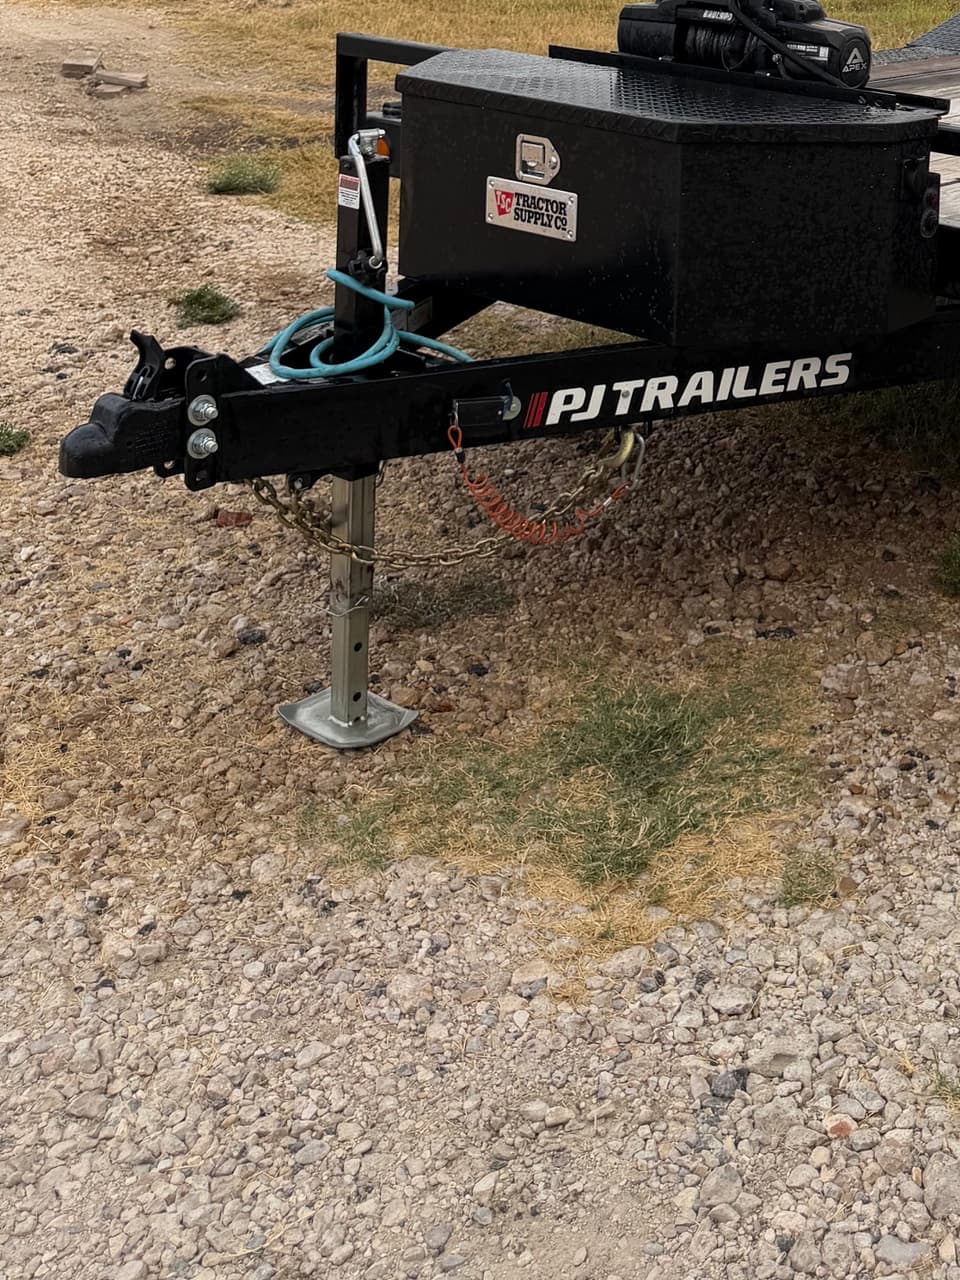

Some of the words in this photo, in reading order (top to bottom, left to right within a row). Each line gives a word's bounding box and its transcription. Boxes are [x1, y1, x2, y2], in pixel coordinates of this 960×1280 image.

[842, 62, 867, 73] APEX
[495, 191, 512, 213] TSC
[514, 192, 568, 216] TRACTOR
[514, 207, 554, 228] SUPPLY
[545, 384, 606, 426] PJ
[611, 352, 853, 416] TRAILERS
